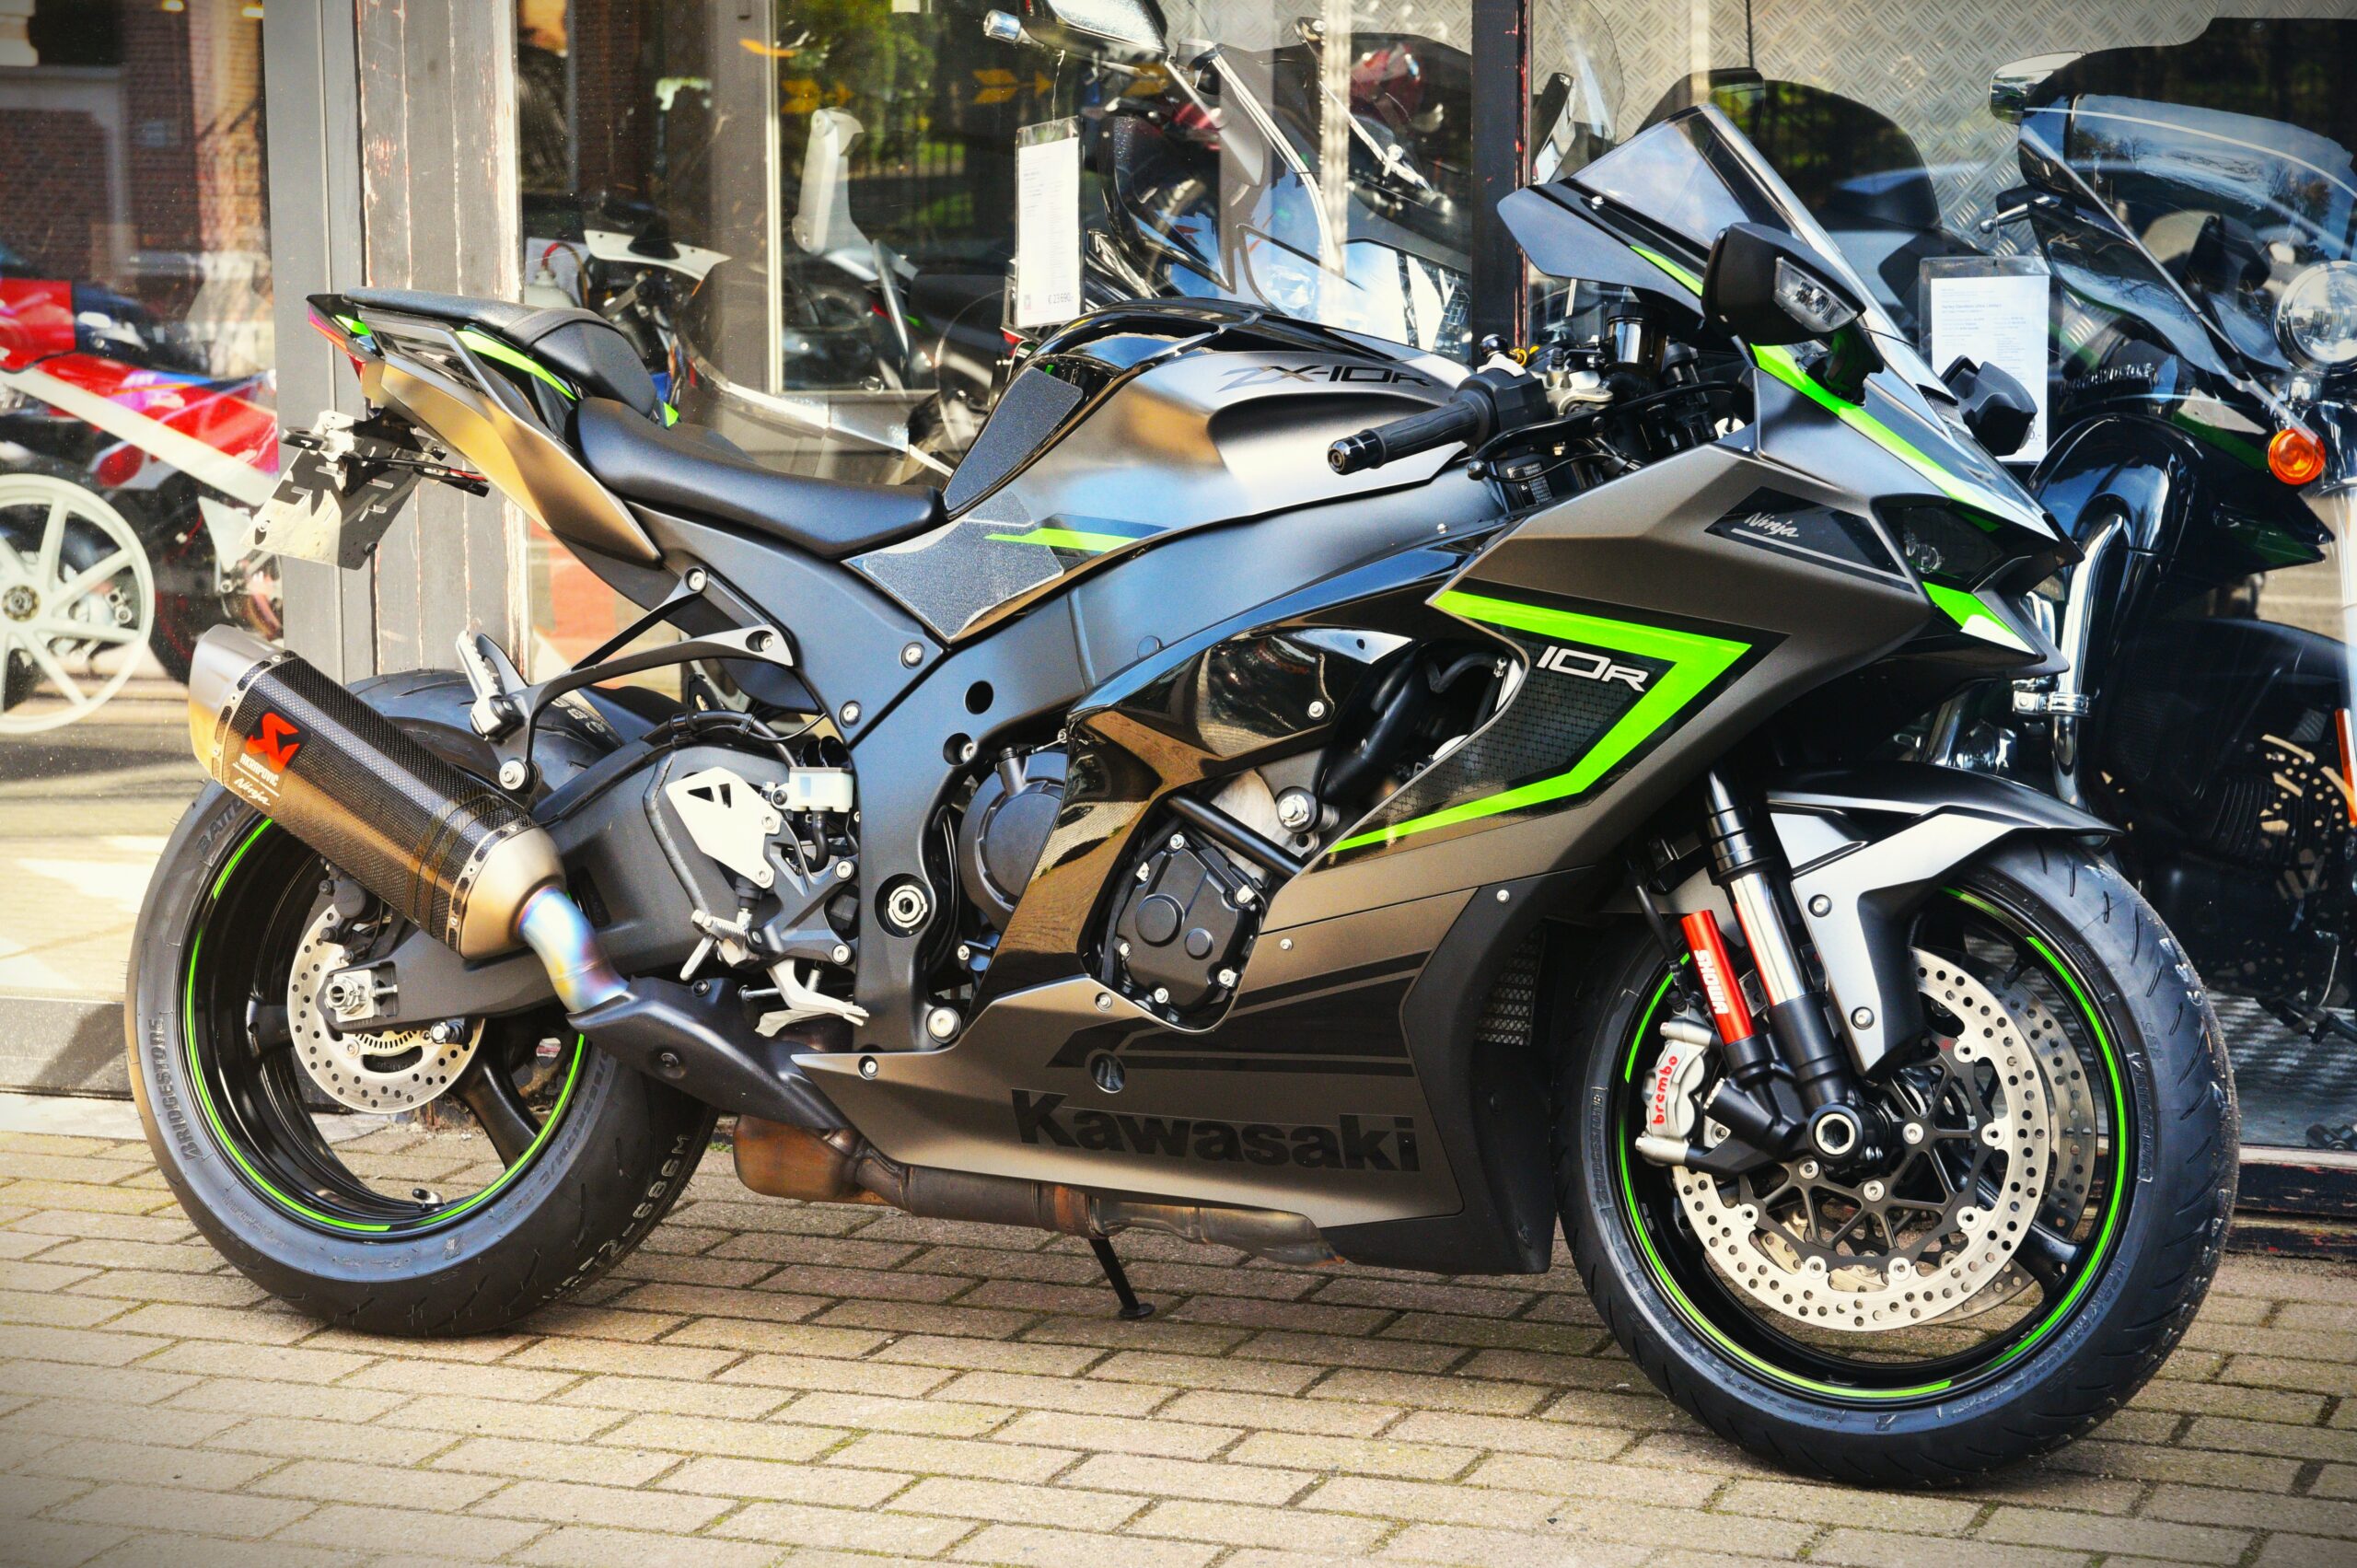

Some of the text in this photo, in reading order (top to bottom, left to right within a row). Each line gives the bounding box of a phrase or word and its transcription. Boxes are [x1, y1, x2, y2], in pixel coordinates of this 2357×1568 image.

[1214, 364, 1432, 394] ZX-10R
[1743, 511, 1800, 538] Ninja
[1536, 645, 1649, 692] 10R
[233, 777, 272, 807] Ninja
[1693, 948, 1731, 1015] SHOWA
[148, 1017, 204, 1161] BRIDGESTONE
[1652, 1055, 1678, 1125] brembo
[1011, 1087, 1422, 1172] Kawasaki
